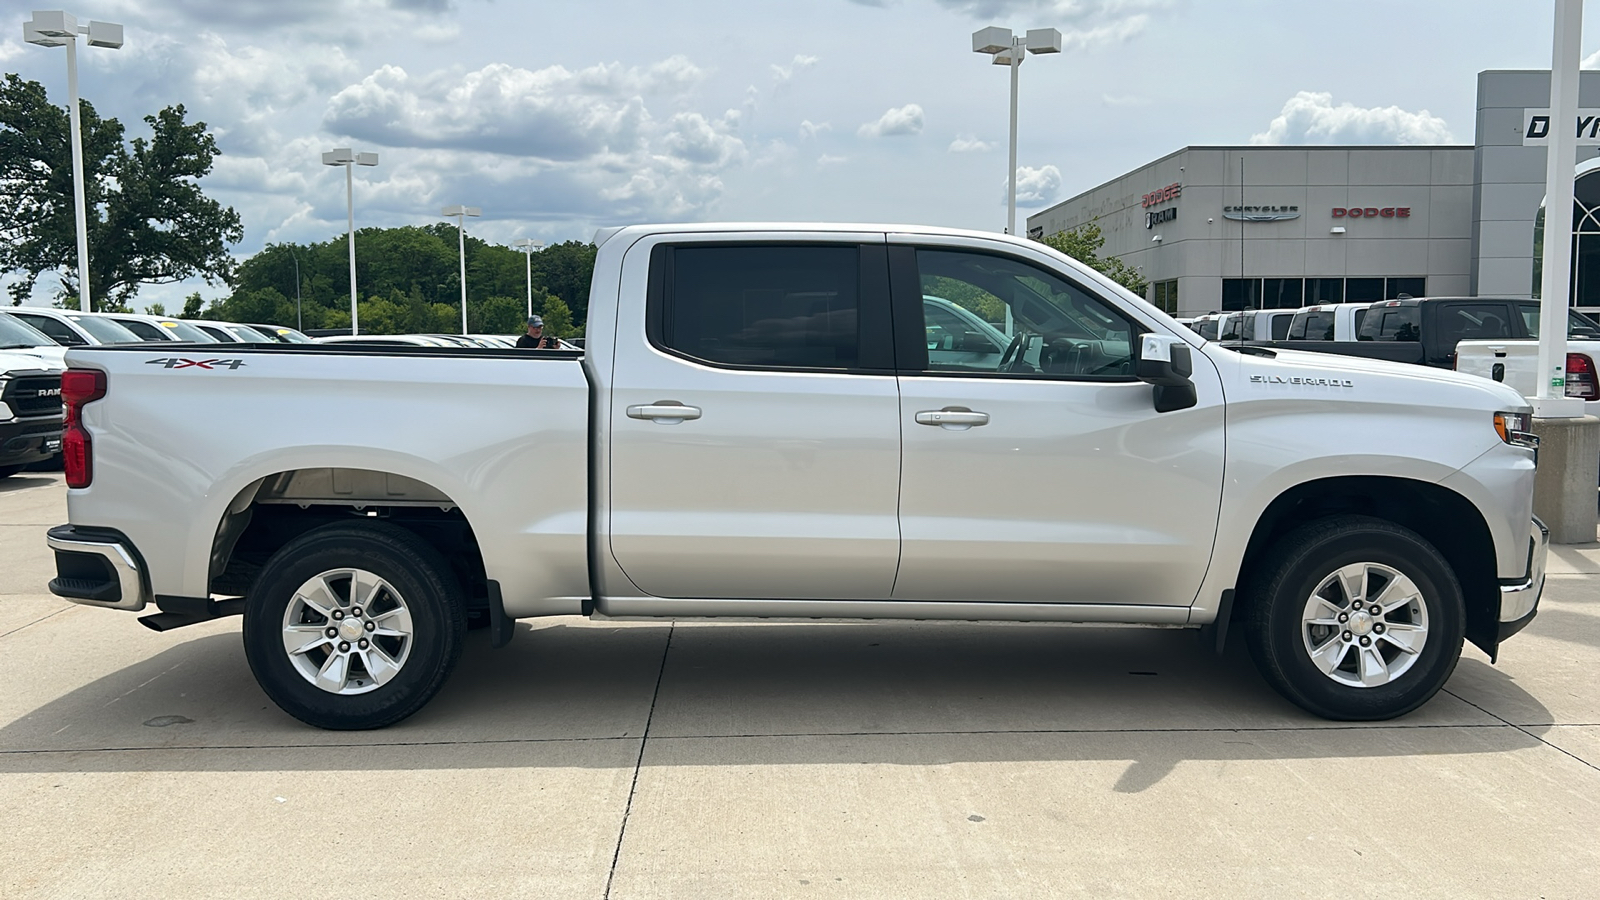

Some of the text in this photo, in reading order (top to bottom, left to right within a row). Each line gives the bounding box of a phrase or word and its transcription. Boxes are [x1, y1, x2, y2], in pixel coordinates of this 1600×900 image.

[1526, 116, 1600, 138] DY
[1142, 183, 1181, 208] DODGE
[1151, 208, 1177, 225] RAM
[1223, 205, 1299, 213] CHRYSLER
[1331, 207, 1411, 218] DODGE
[1250, 374, 1353, 388] SILVERADO
